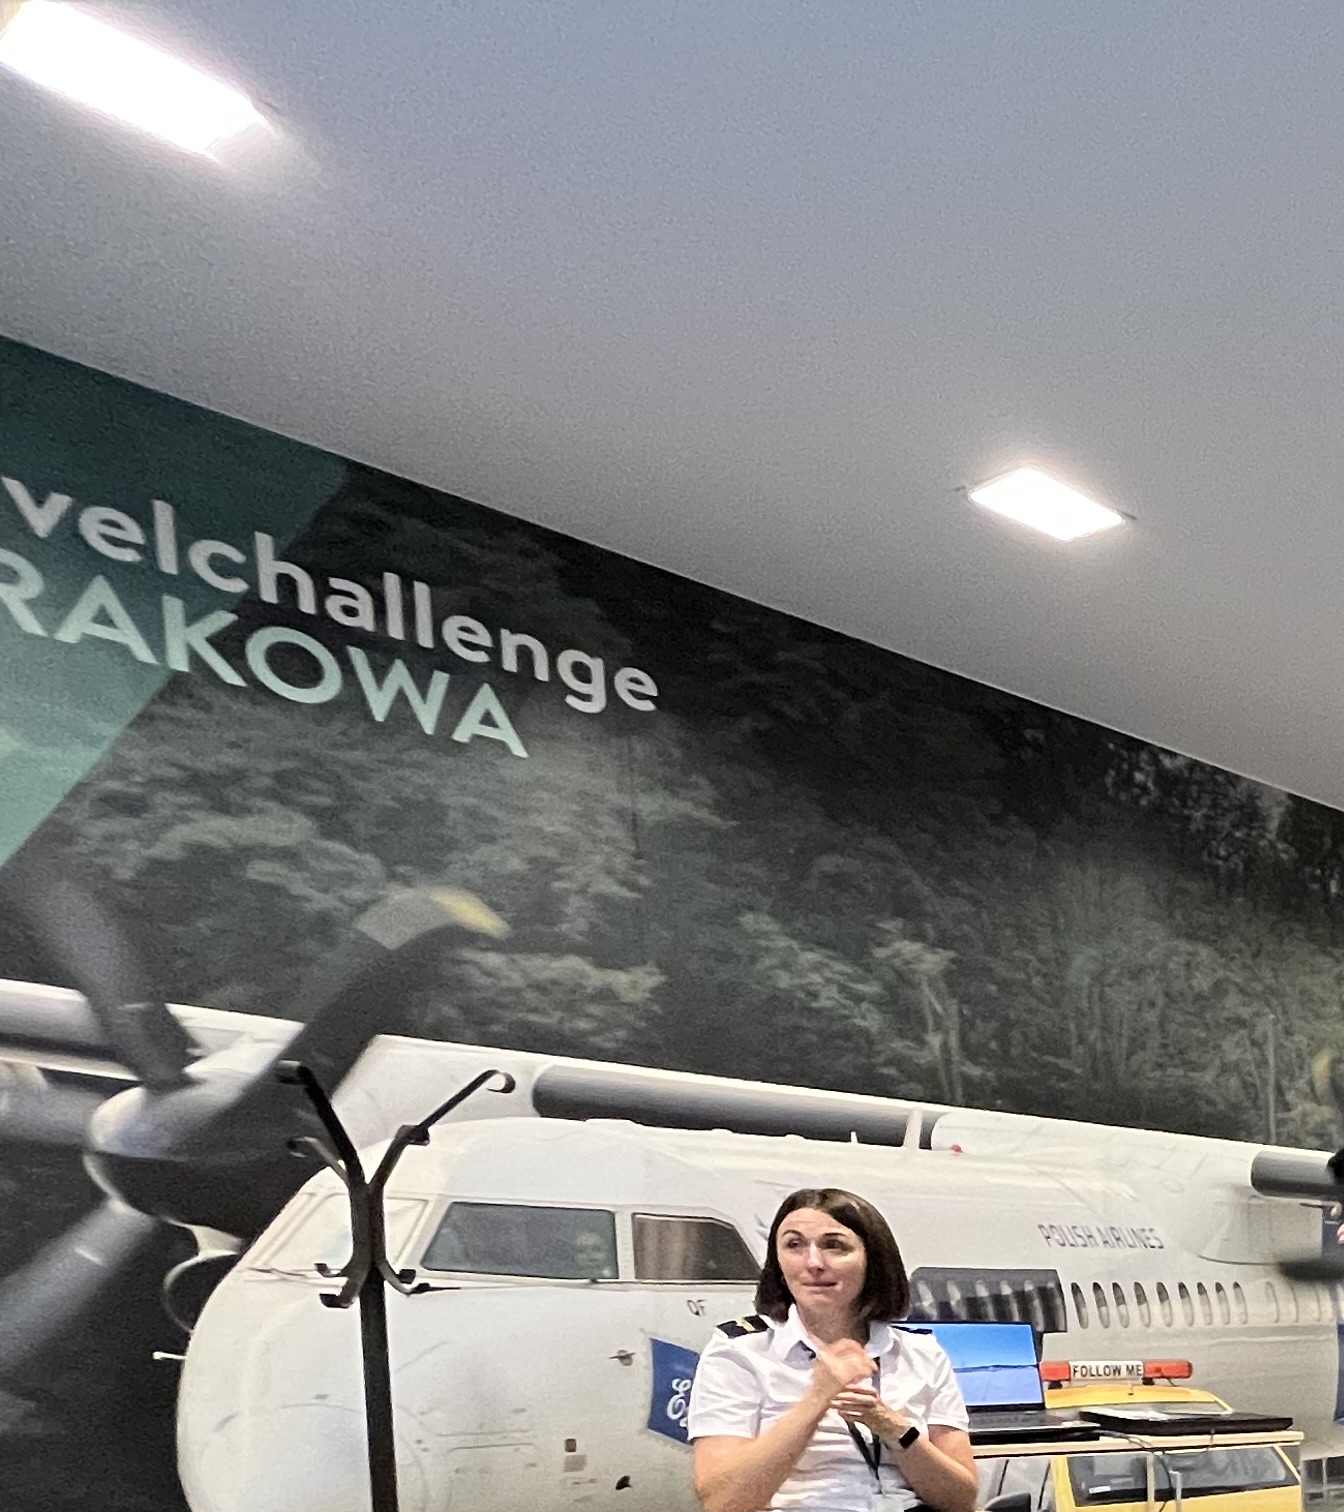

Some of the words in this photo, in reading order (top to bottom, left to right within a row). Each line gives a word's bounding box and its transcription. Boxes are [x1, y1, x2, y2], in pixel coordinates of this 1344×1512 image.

[0, 547, 528, 758] RAKOWA
[2, 476, 659, 713] velchallenge
[1037, 1223, 1098, 1248] POLISH
[1096, 1226, 1164, 1249] AIRLINES
[1072, 1364, 1122, 1378] FOLLOW
[1125, 1364, 1143, 1376] ME
